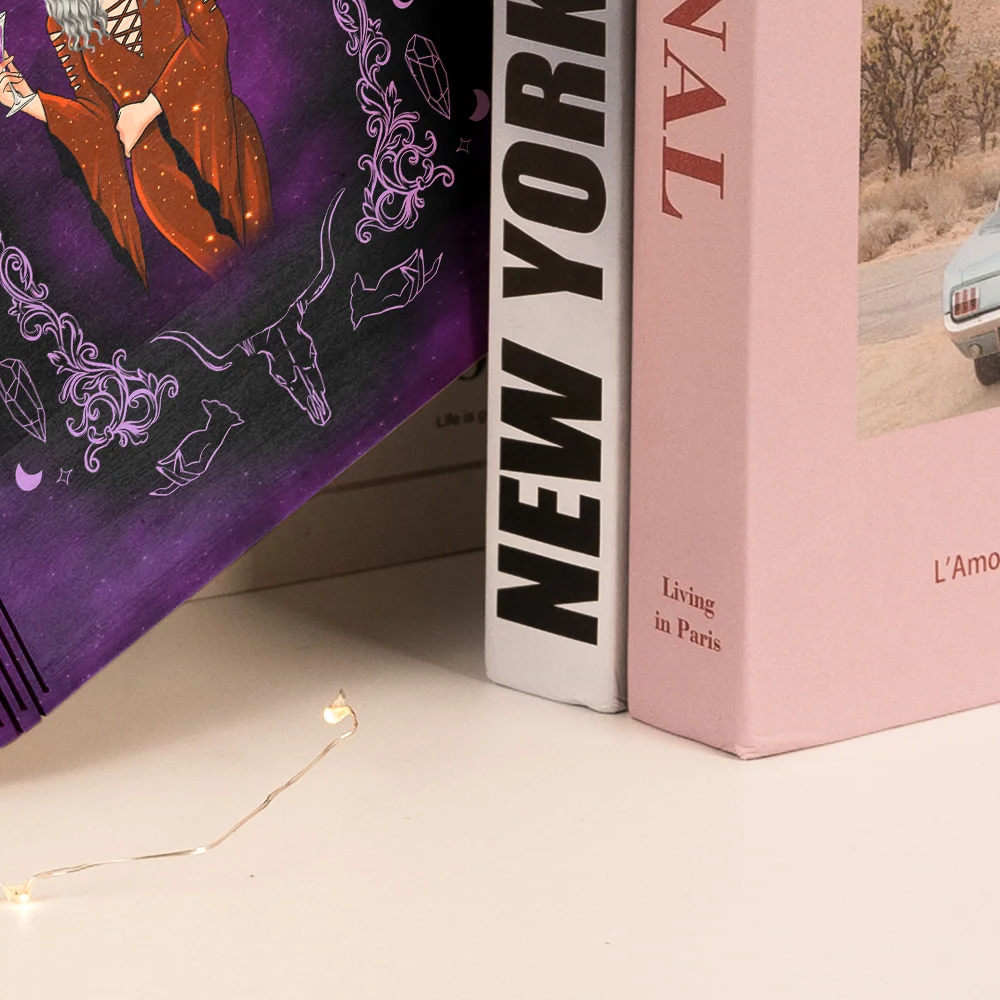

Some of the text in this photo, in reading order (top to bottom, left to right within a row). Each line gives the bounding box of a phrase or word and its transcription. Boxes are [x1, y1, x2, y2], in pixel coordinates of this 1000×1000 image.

[496, 336, 603, 646] NEW
[662, 575, 716, 620] Living
[654, 610, 722, 652] in Paris
